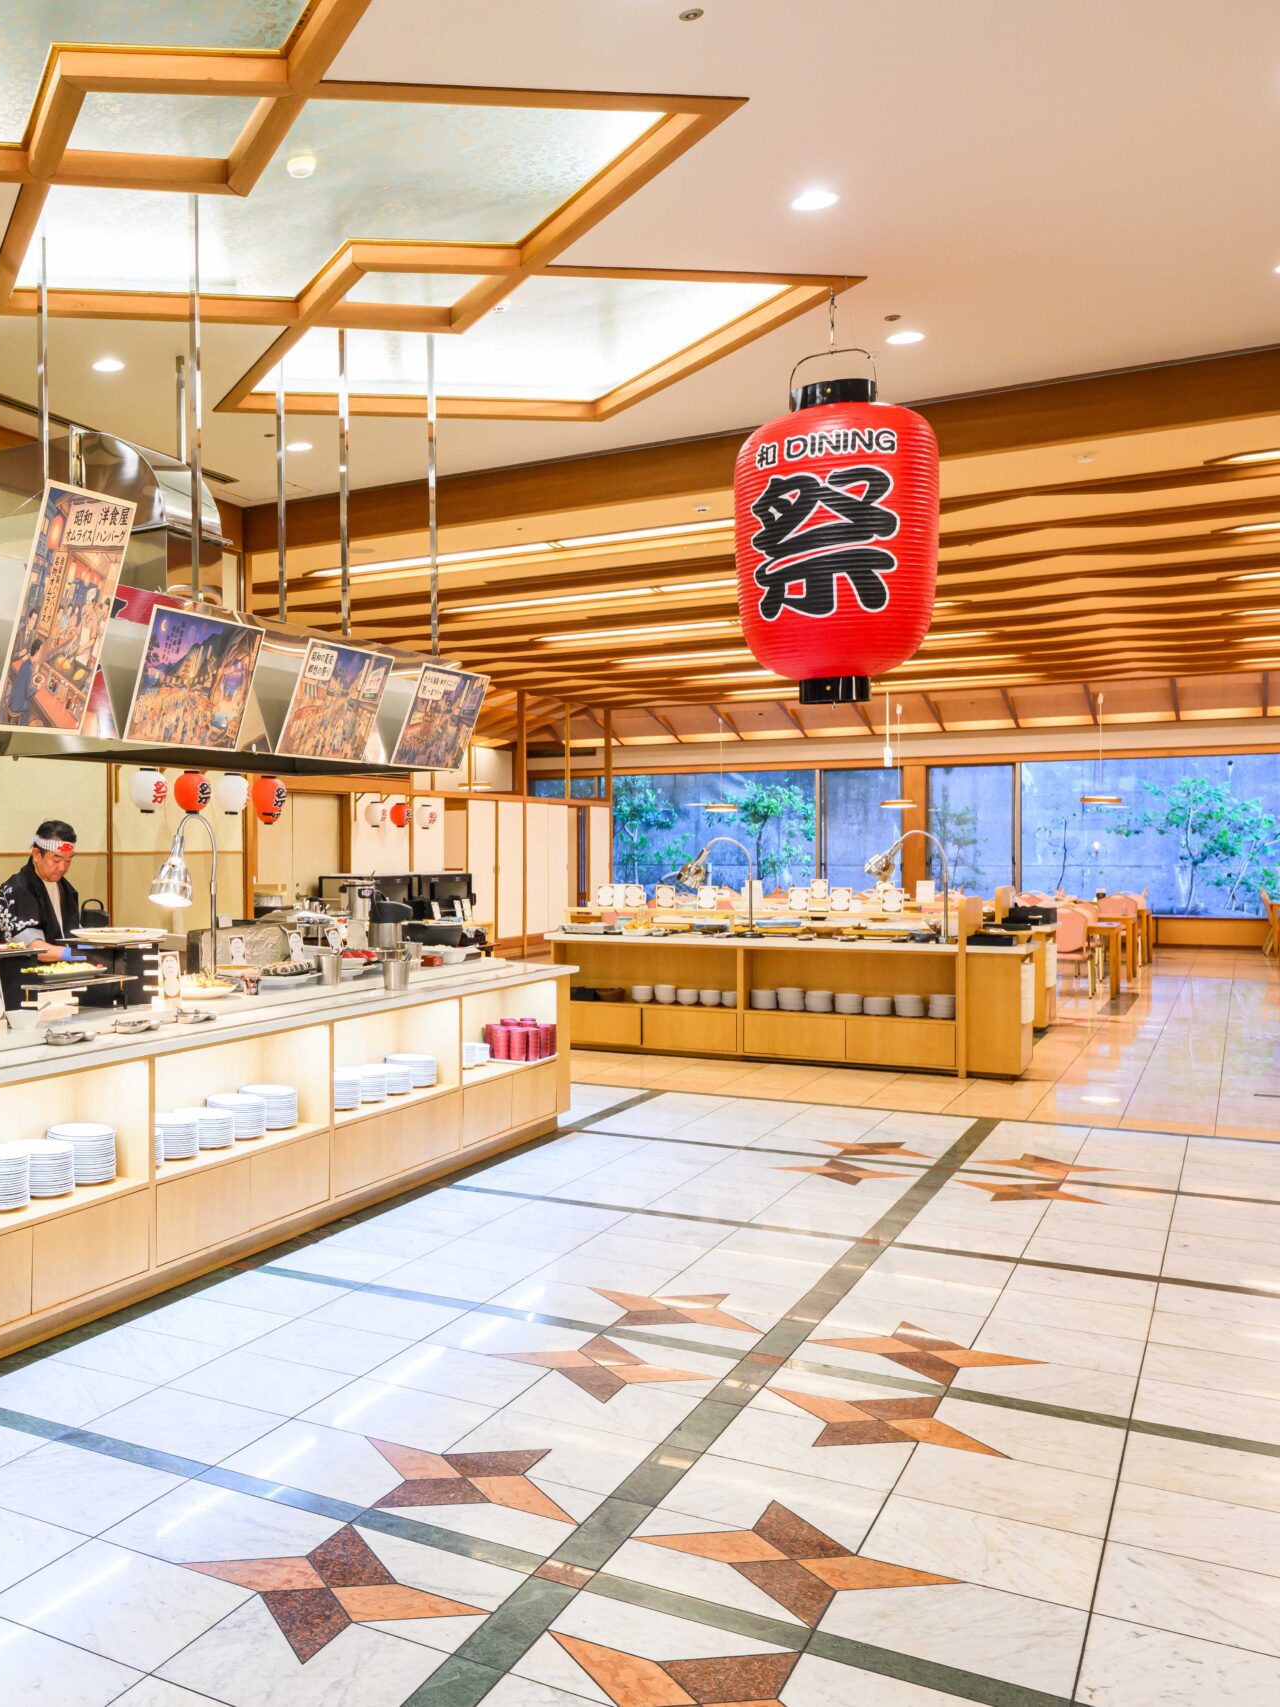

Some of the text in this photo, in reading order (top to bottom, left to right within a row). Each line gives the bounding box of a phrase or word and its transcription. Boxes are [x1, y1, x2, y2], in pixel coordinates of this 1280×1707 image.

[756, 427, 897, 469] 和 DINING
[74, 505, 131, 526] 昭和 洋食屋
[65, 529, 128, 544] オムライス ハンバーグ
[751, 464, 900, 622] 祭
